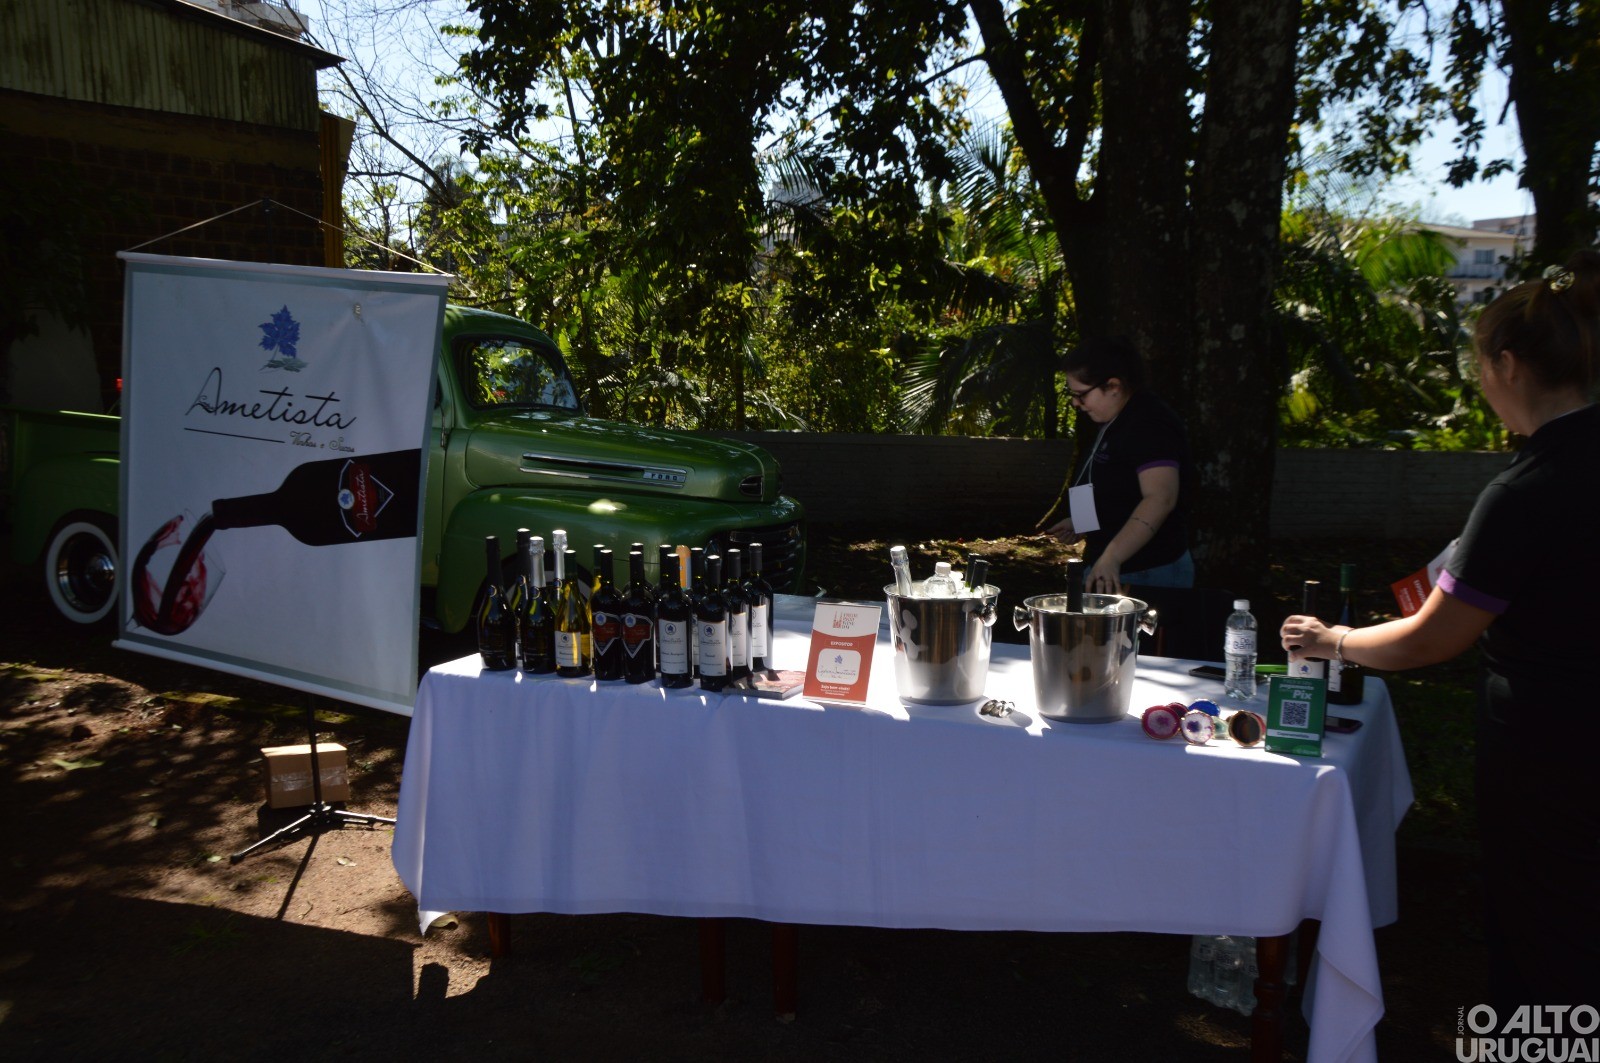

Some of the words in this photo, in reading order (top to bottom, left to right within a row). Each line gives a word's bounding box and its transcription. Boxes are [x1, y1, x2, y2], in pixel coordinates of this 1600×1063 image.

[185, 366, 357, 430] Ametista
[651, 472, 678, 481] FORD
[1292, 689, 1313, 700] Pix
